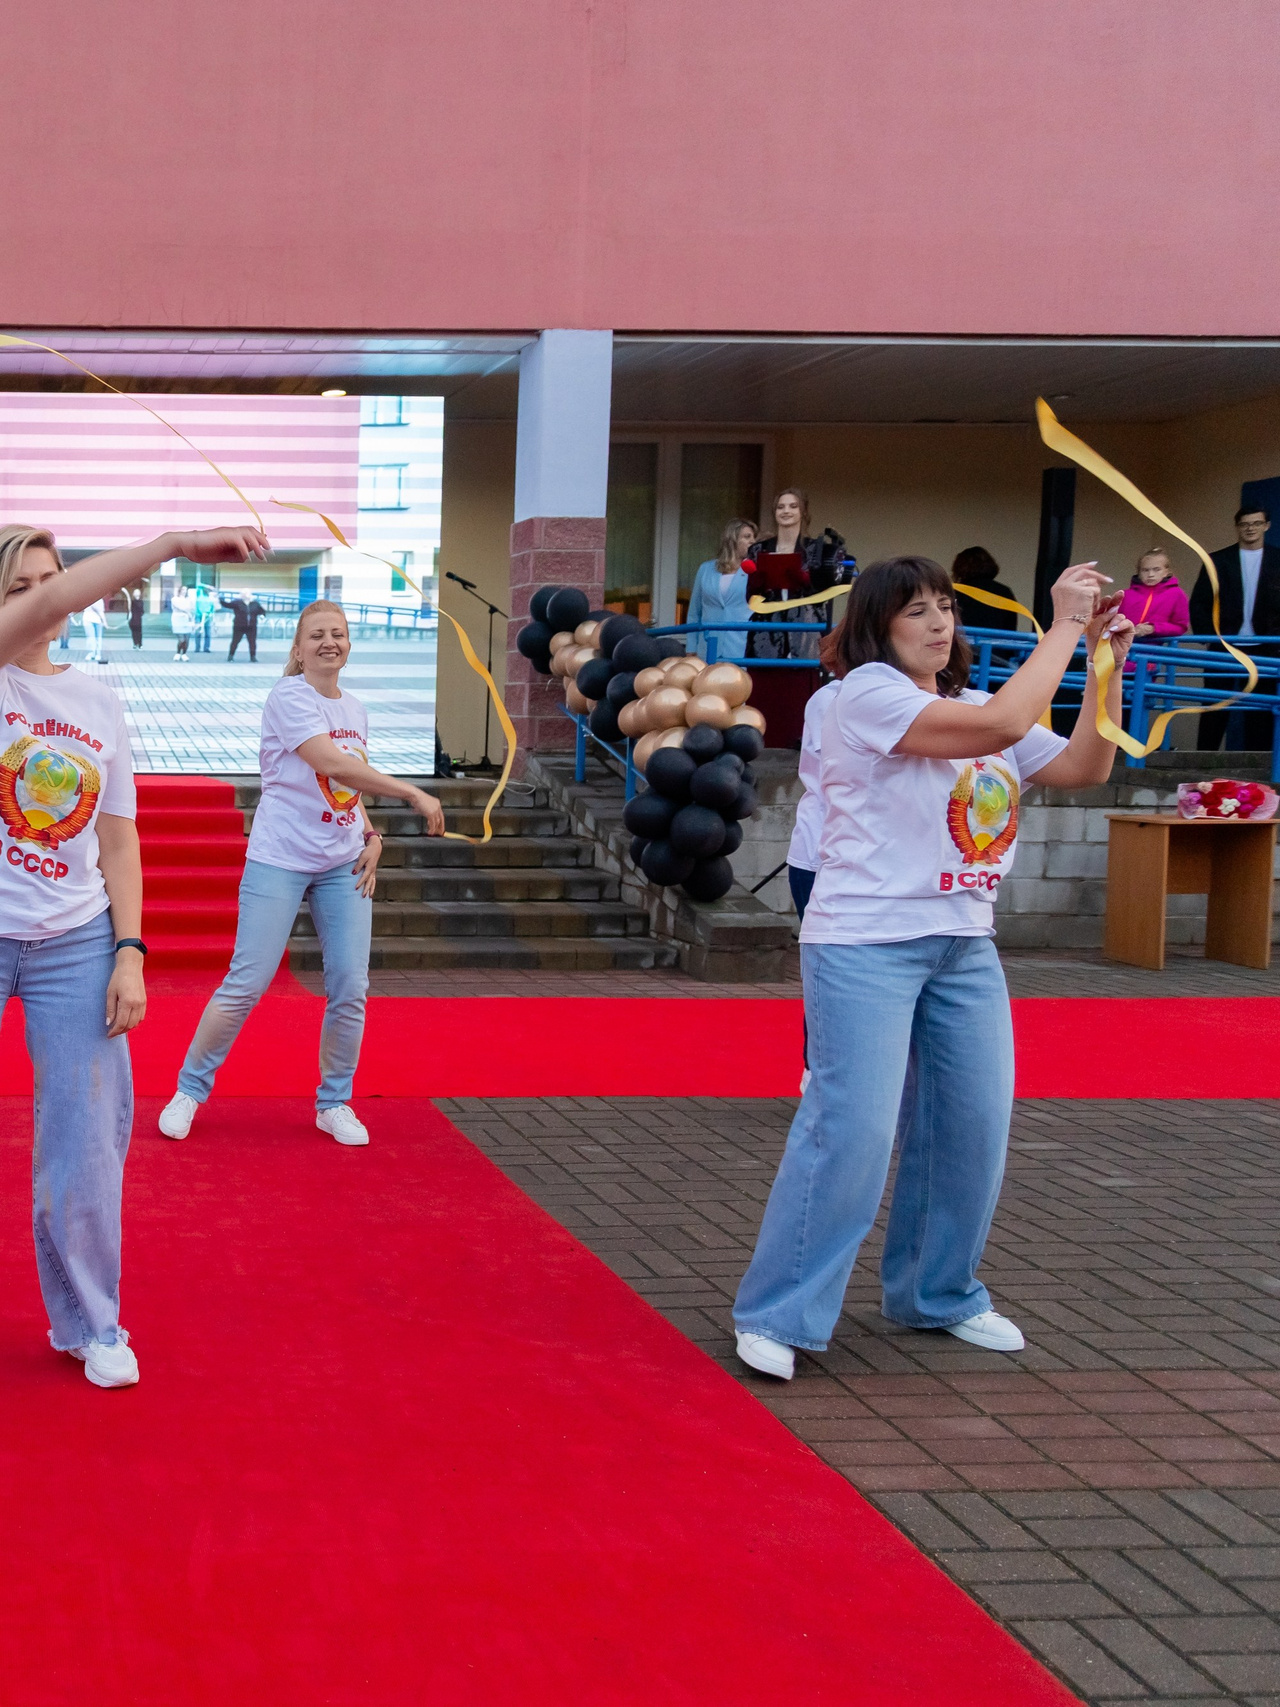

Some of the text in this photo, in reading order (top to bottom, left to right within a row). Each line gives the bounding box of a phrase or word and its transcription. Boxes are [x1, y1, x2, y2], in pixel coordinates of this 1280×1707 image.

[5, 711, 103, 753] РОДЁННАЯ
[321, 811, 332, 823] В
[6, 845, 69, 881] СССР
[939, 872, 953, 891] В
